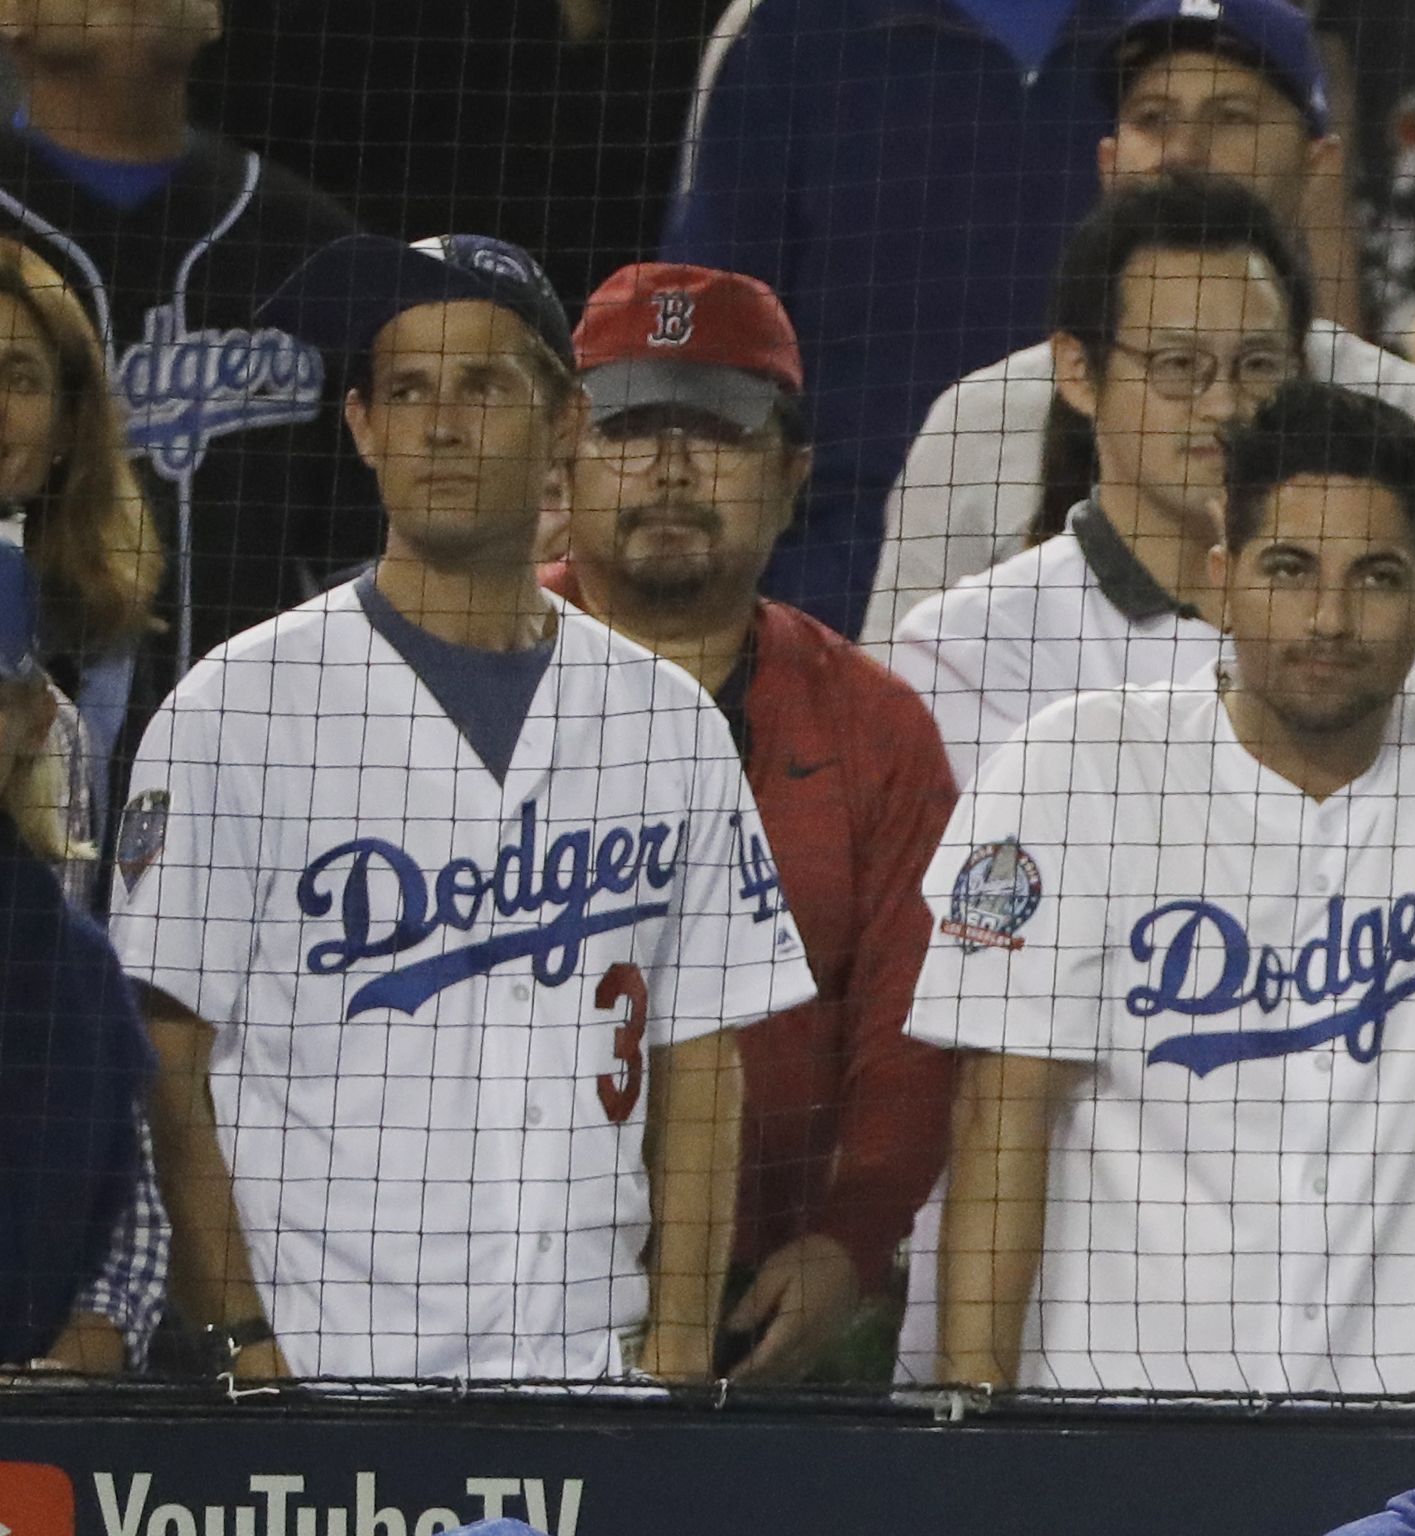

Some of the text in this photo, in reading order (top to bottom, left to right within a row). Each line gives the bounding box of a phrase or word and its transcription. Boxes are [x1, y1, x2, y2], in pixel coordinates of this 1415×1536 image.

[647, 290, 695, 347] B
[297, 799, 687, 987] Dodger
[595, 962, 649, 1123] 3
